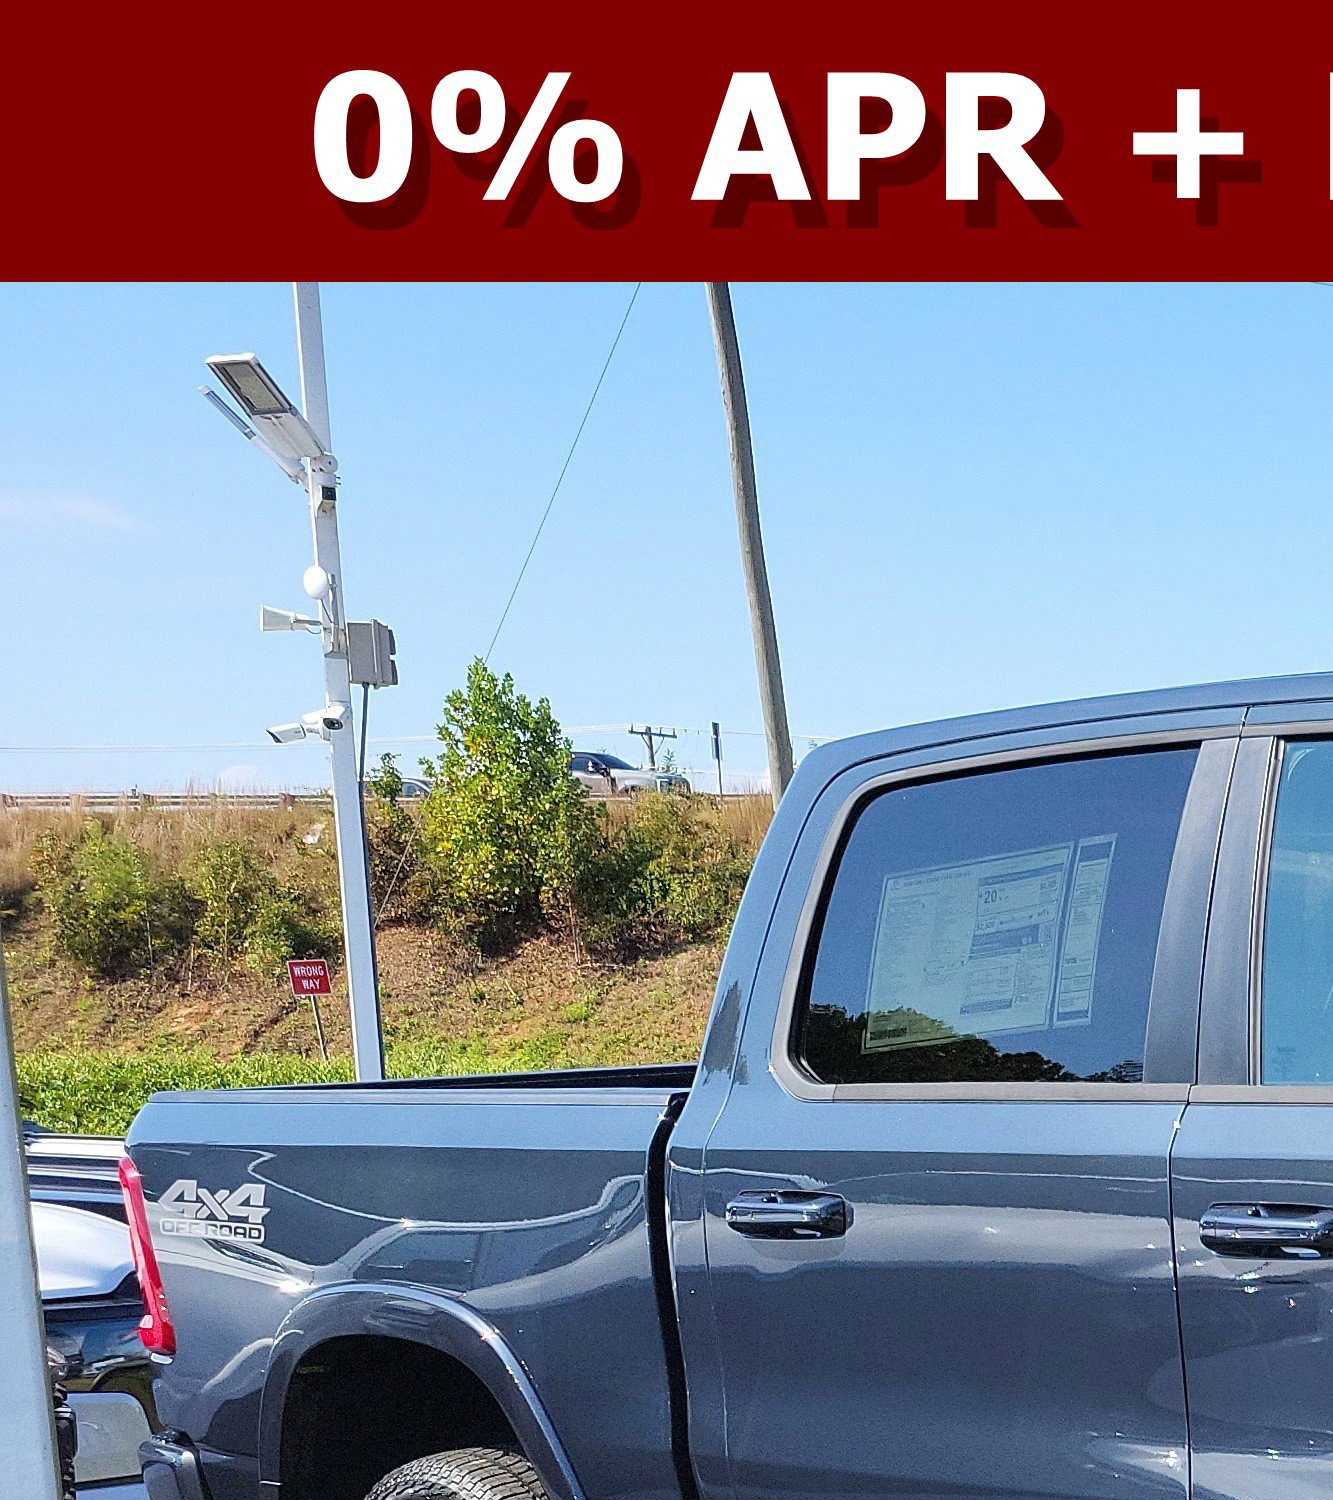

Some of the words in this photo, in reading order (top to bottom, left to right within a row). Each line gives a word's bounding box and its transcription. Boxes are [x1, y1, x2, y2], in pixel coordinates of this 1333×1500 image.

[293, 965, 324, 977] WRONG
[301, 979, 320, 990] WAY
[205, 1224, 262, 1240] ROAD
